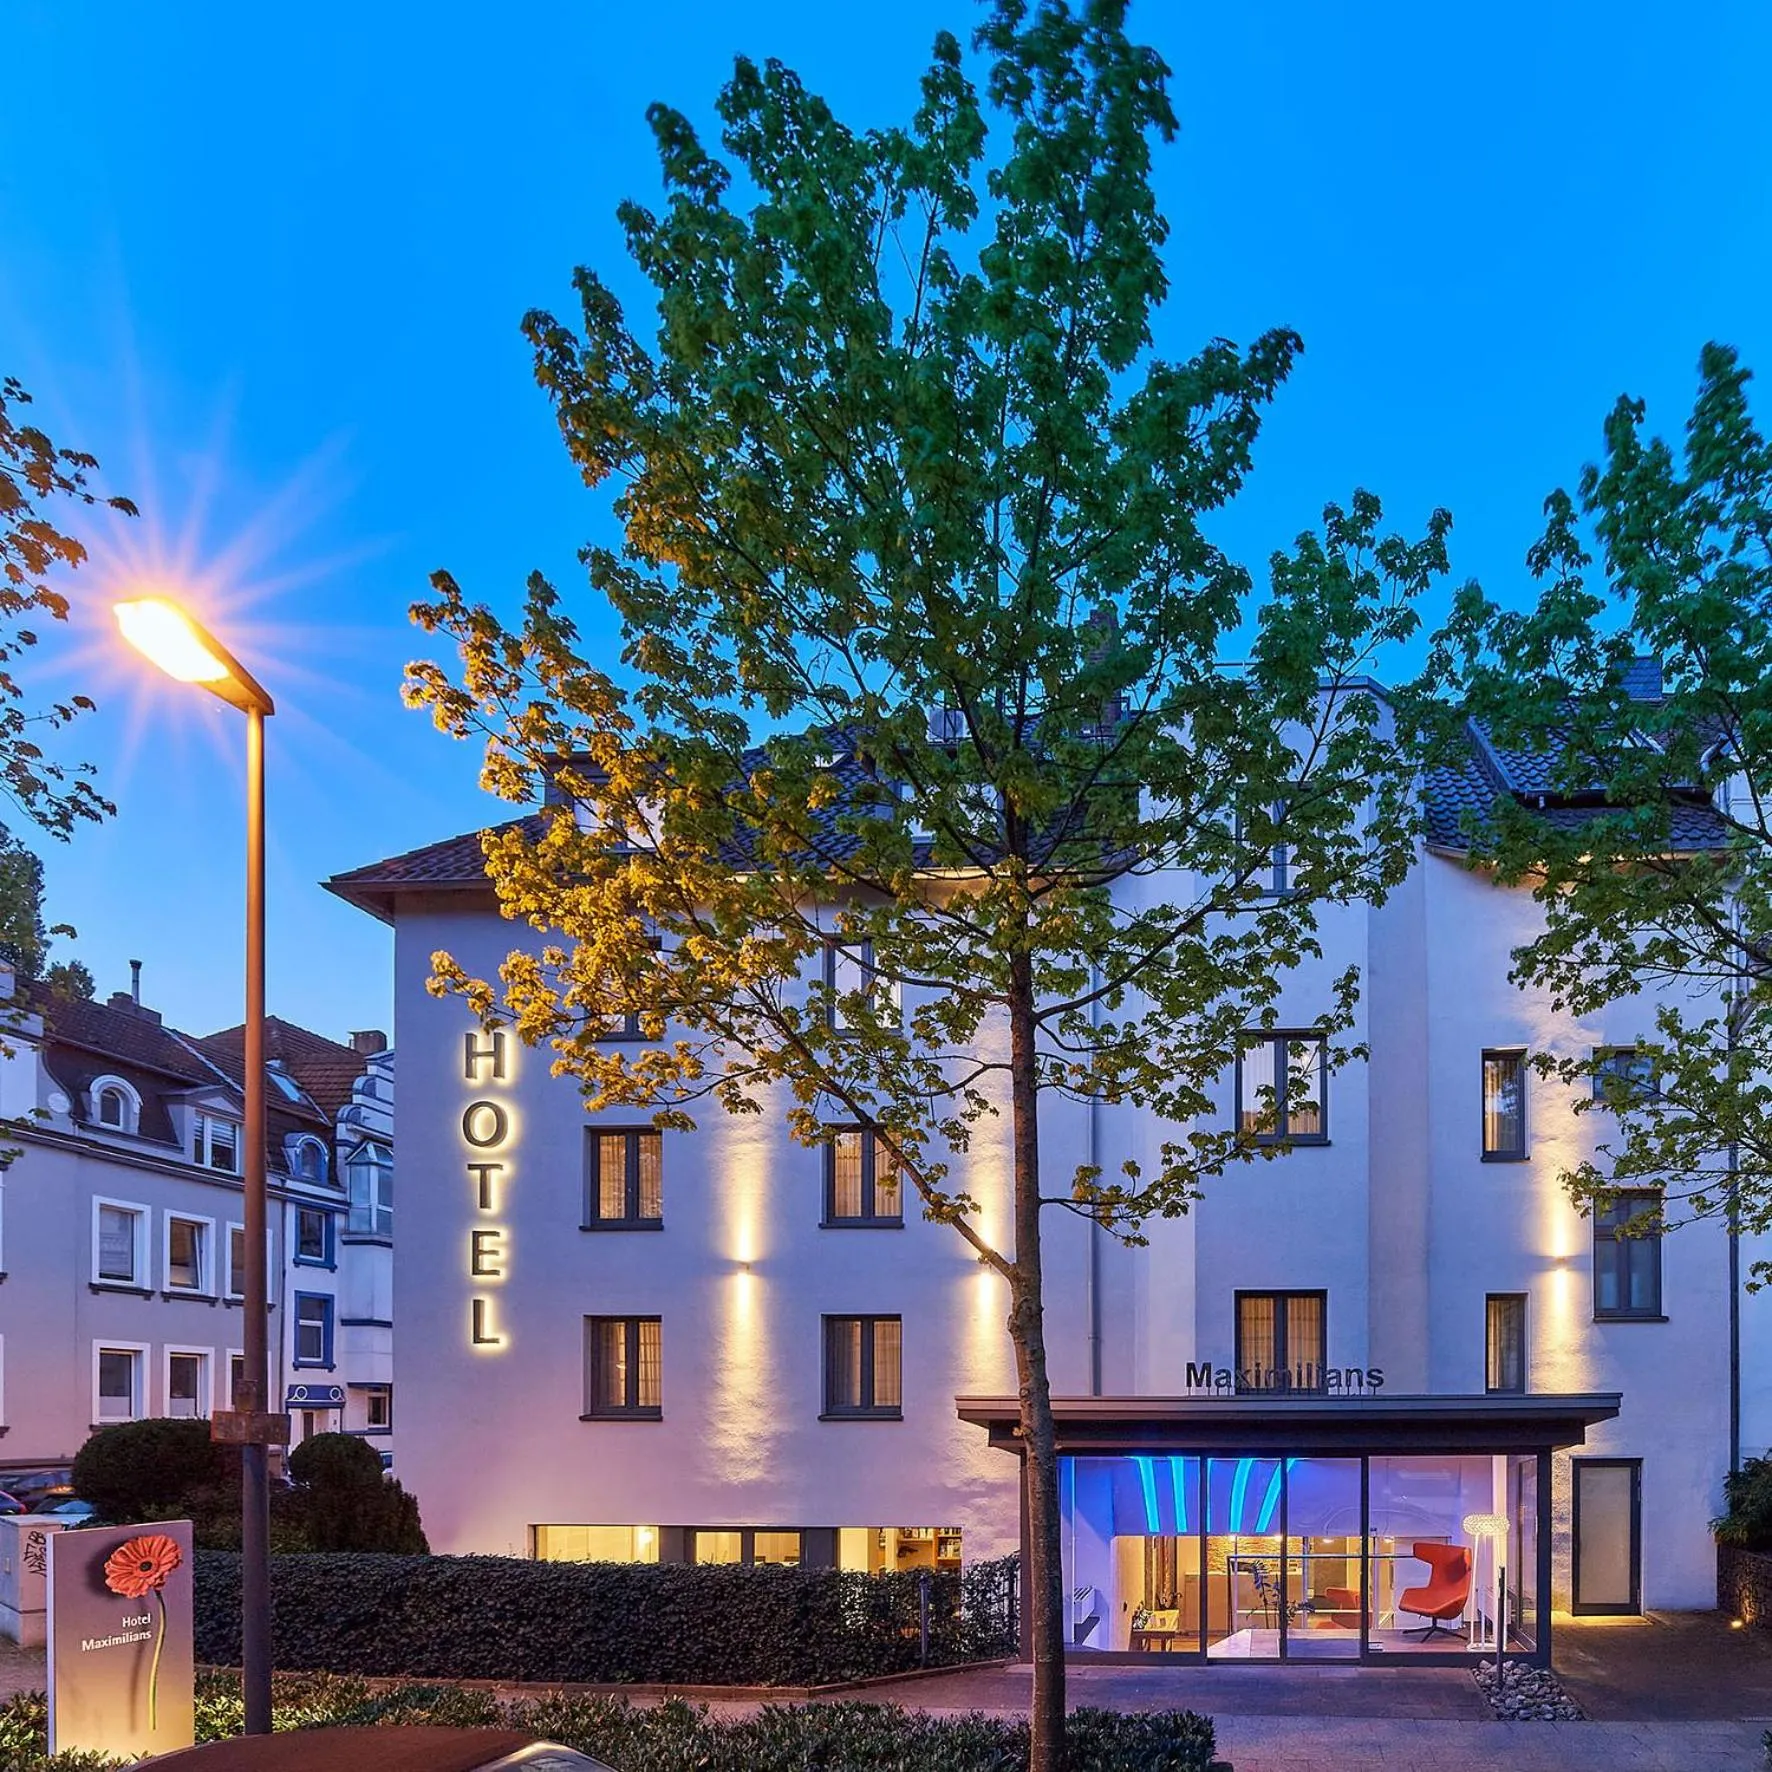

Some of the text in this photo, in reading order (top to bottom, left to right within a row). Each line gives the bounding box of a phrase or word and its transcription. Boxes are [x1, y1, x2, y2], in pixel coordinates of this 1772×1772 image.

[462, 1031, 508, 1345] HOTEL
[1185, 1361, 1385, 1388] Maximilians
[122, 1612, 151, 1628] Hotel
[81, 1630, 152, 1652] Maximilians
